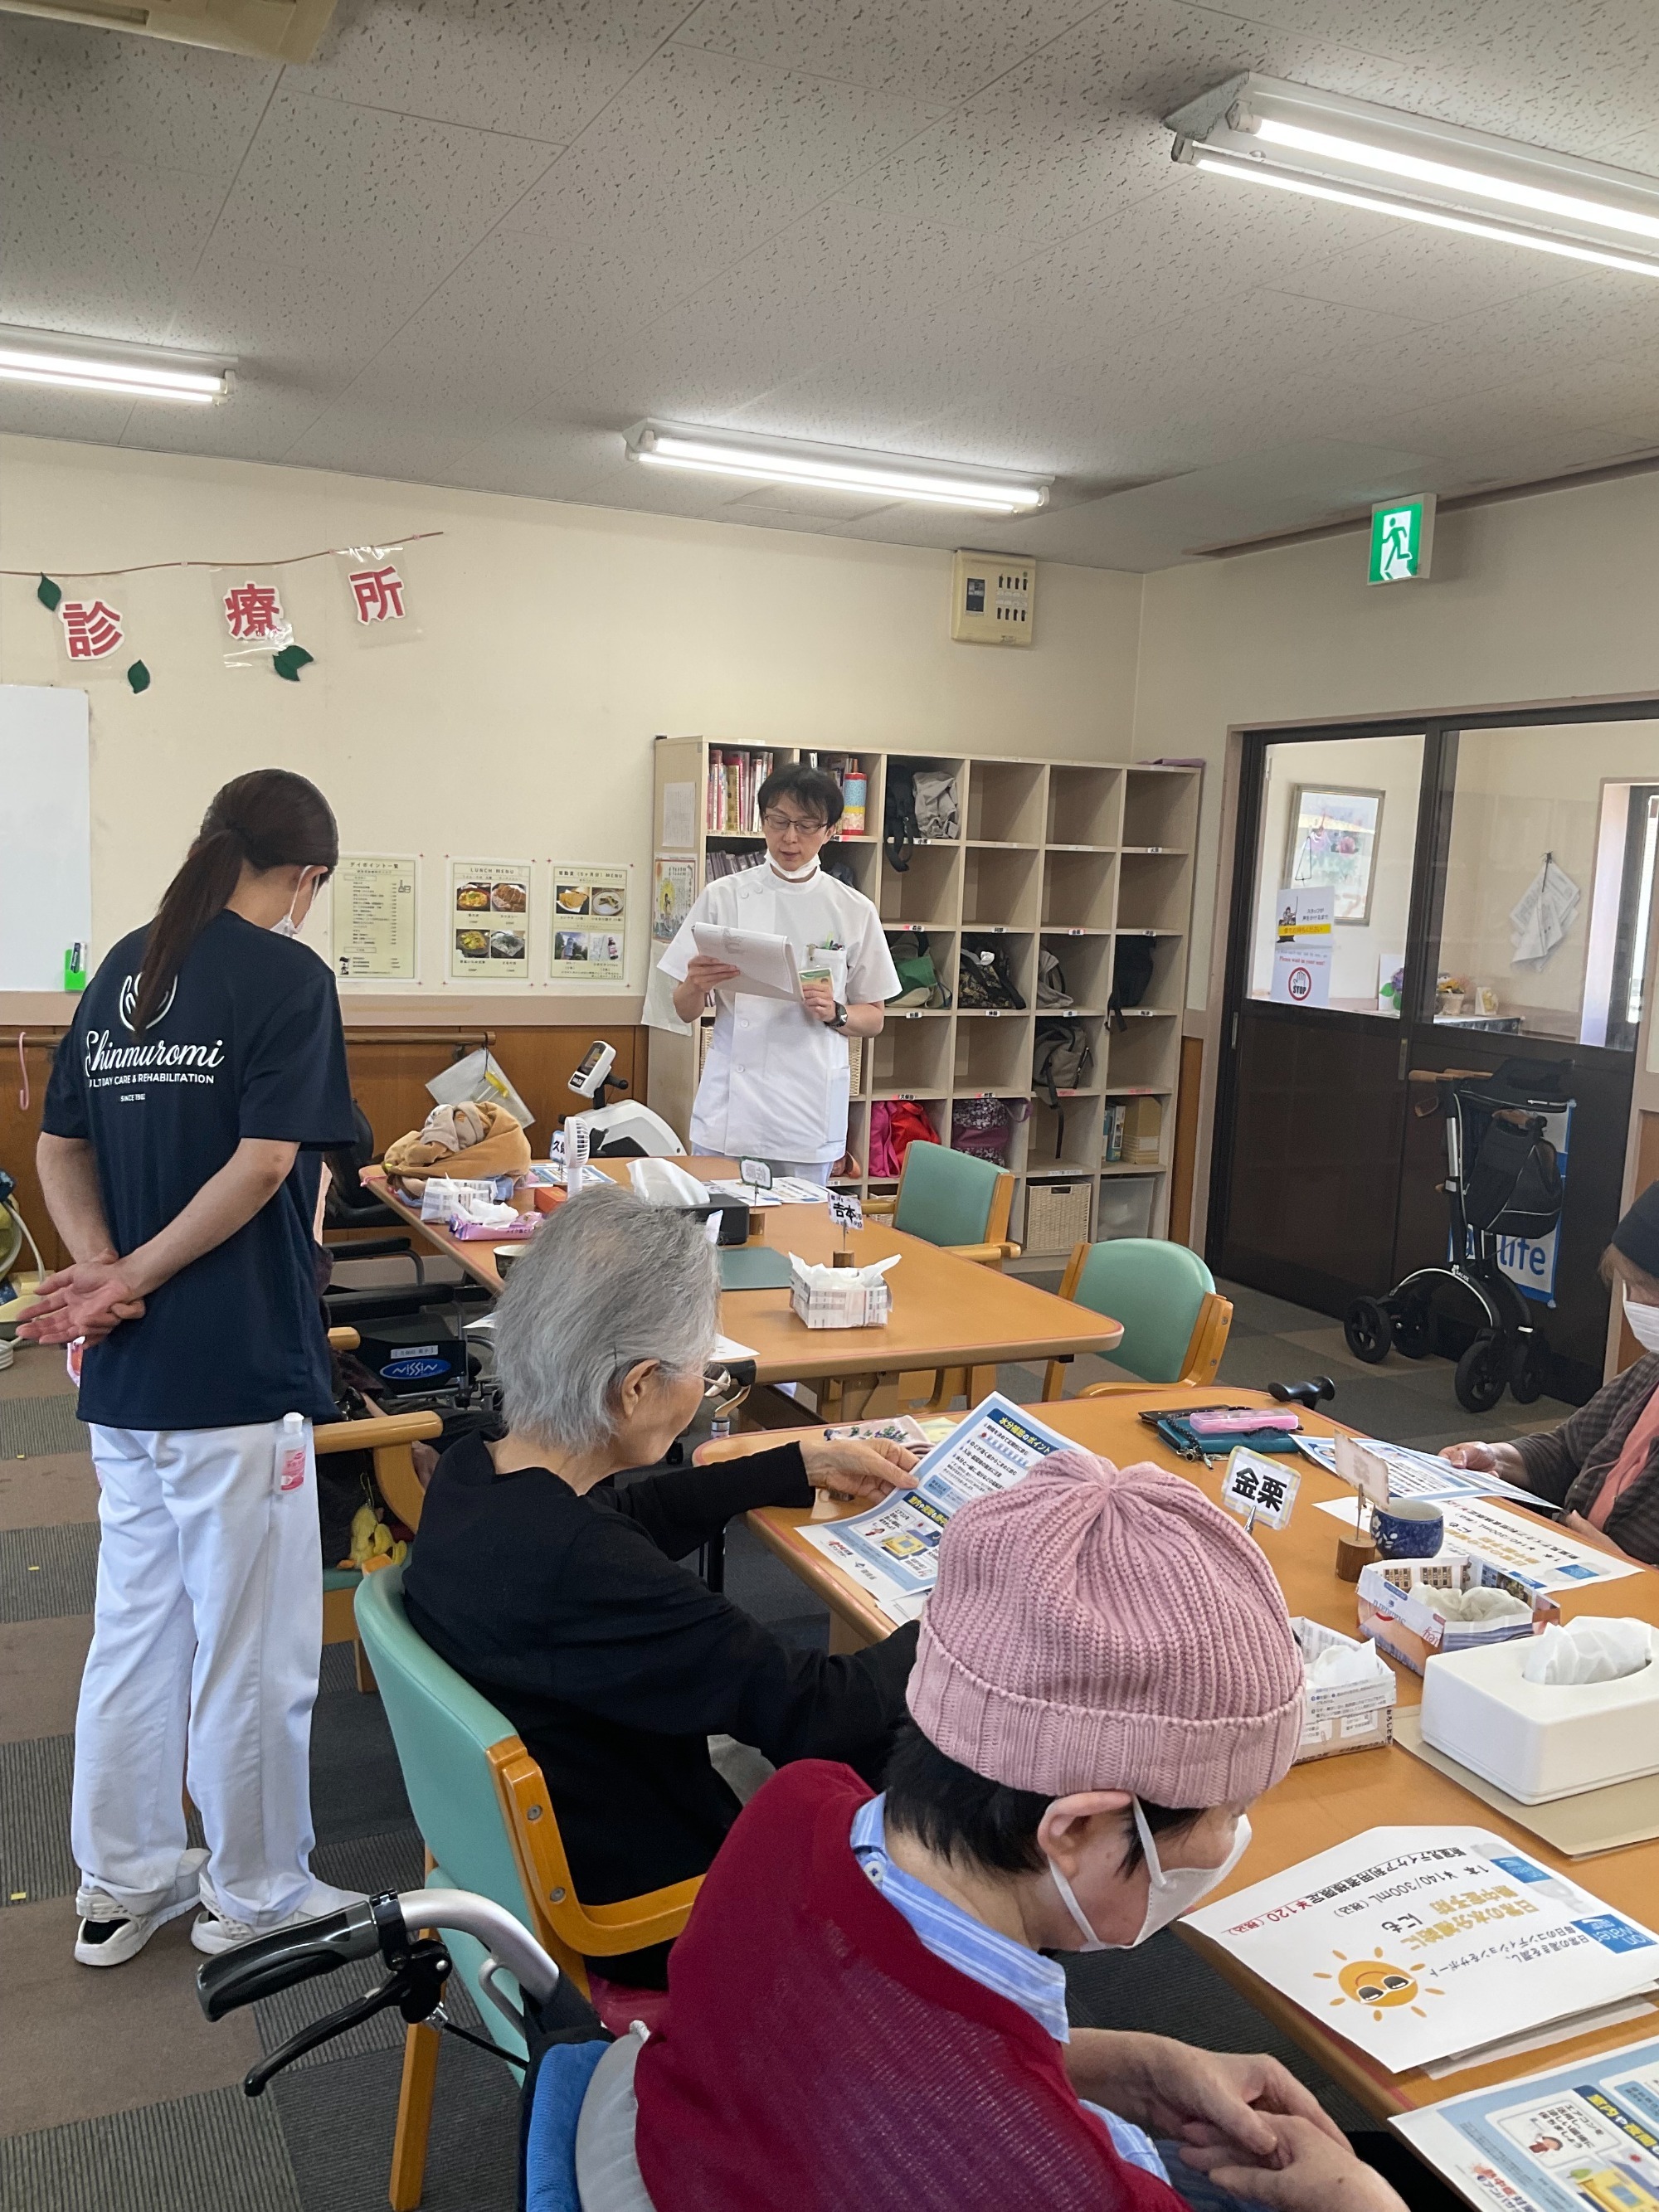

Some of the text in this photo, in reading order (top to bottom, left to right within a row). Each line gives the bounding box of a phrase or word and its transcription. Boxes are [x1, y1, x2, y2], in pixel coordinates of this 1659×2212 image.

[63, 565, 406, 658] 診 療 所
[1292, 985, 1306, 994] STOP
[85, 1029, 226, 1077] Shinmuromi
[114, 1074, 131, 1085] CARE
[132, 1075, 137, 1083] &
[138, 1072, 215, 1084] REHABILITATION
[392, 1361, 438, 1376] NISSIN
[999, 1417, 1051, 1453] 水分補給のポイント
[1231, 1467, 1287, 1513] 金栗
[1380, 1912, 1424, 1934] にも
[1564, 2104, 1604, 2136] エアコンを
